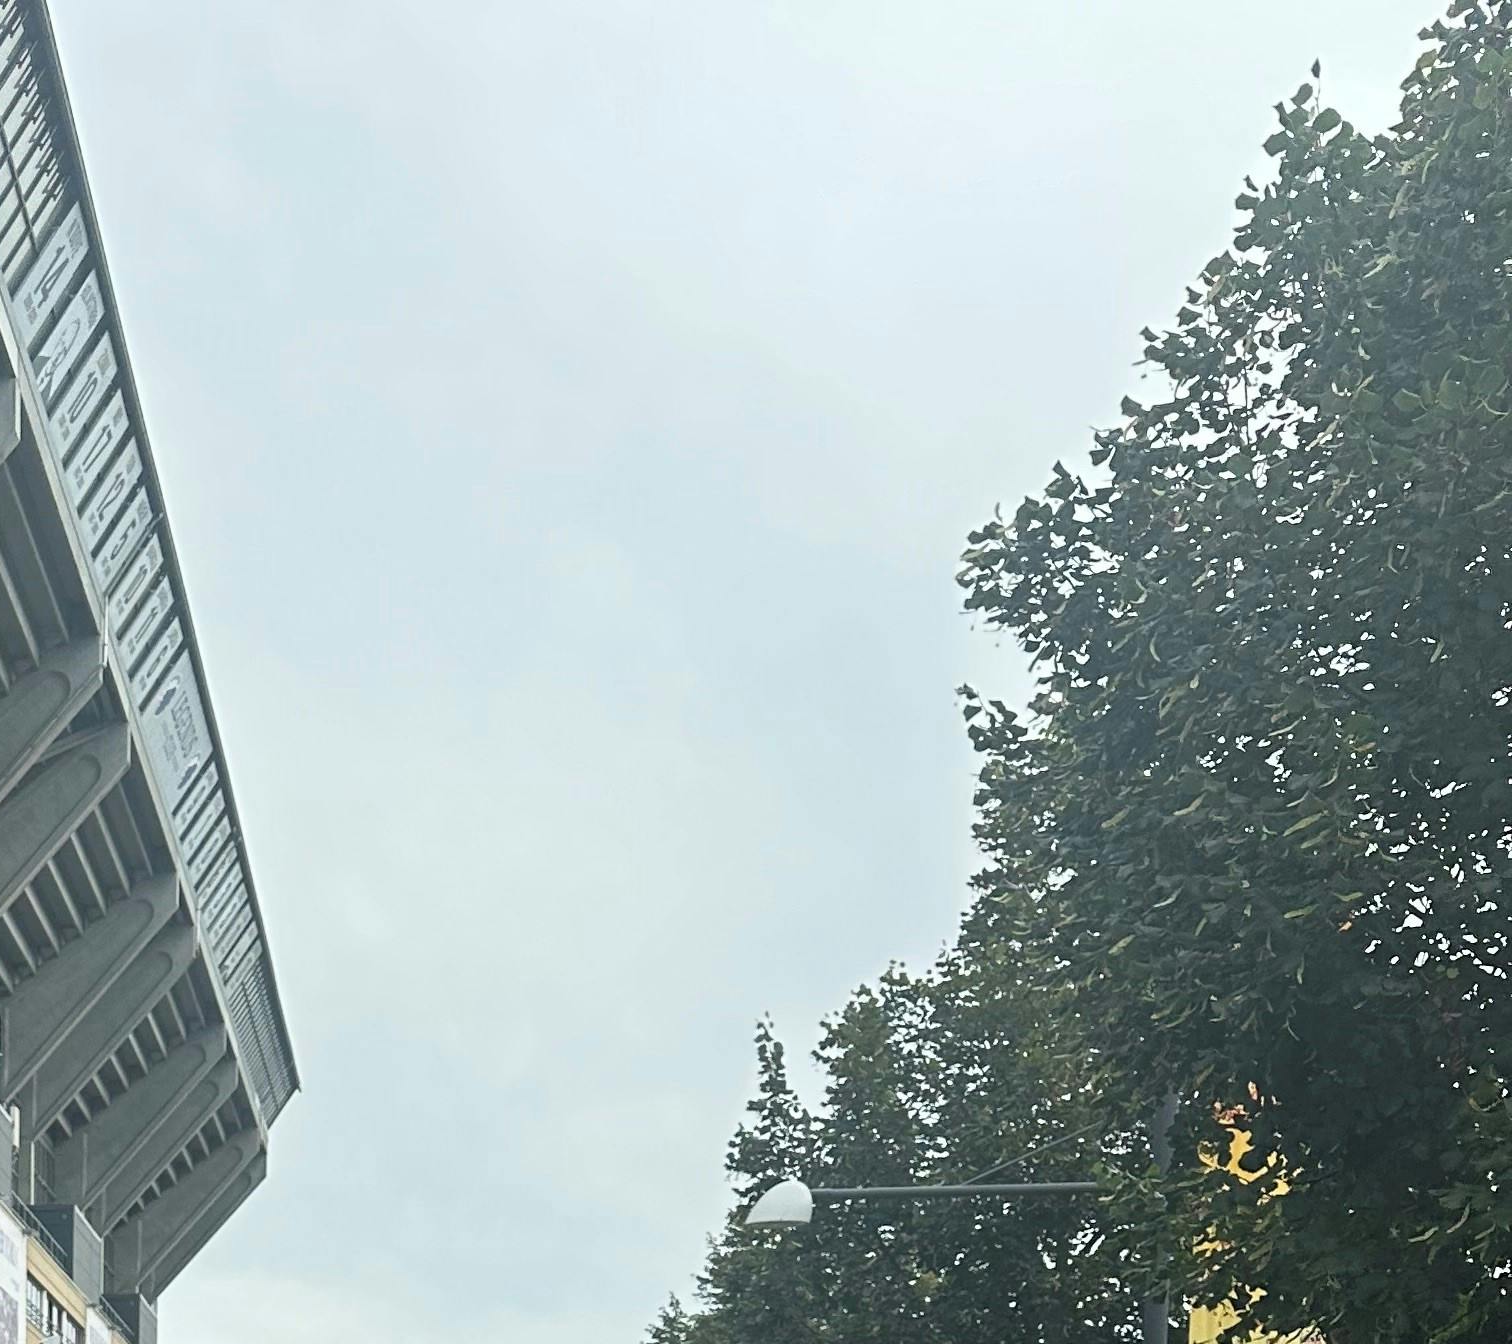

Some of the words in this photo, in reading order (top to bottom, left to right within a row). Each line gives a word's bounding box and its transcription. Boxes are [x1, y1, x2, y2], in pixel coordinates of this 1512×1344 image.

[34, 245, 70, 309] 14
[67, 370, 98, 424] 10
[96, 471, 125, 522] 12
